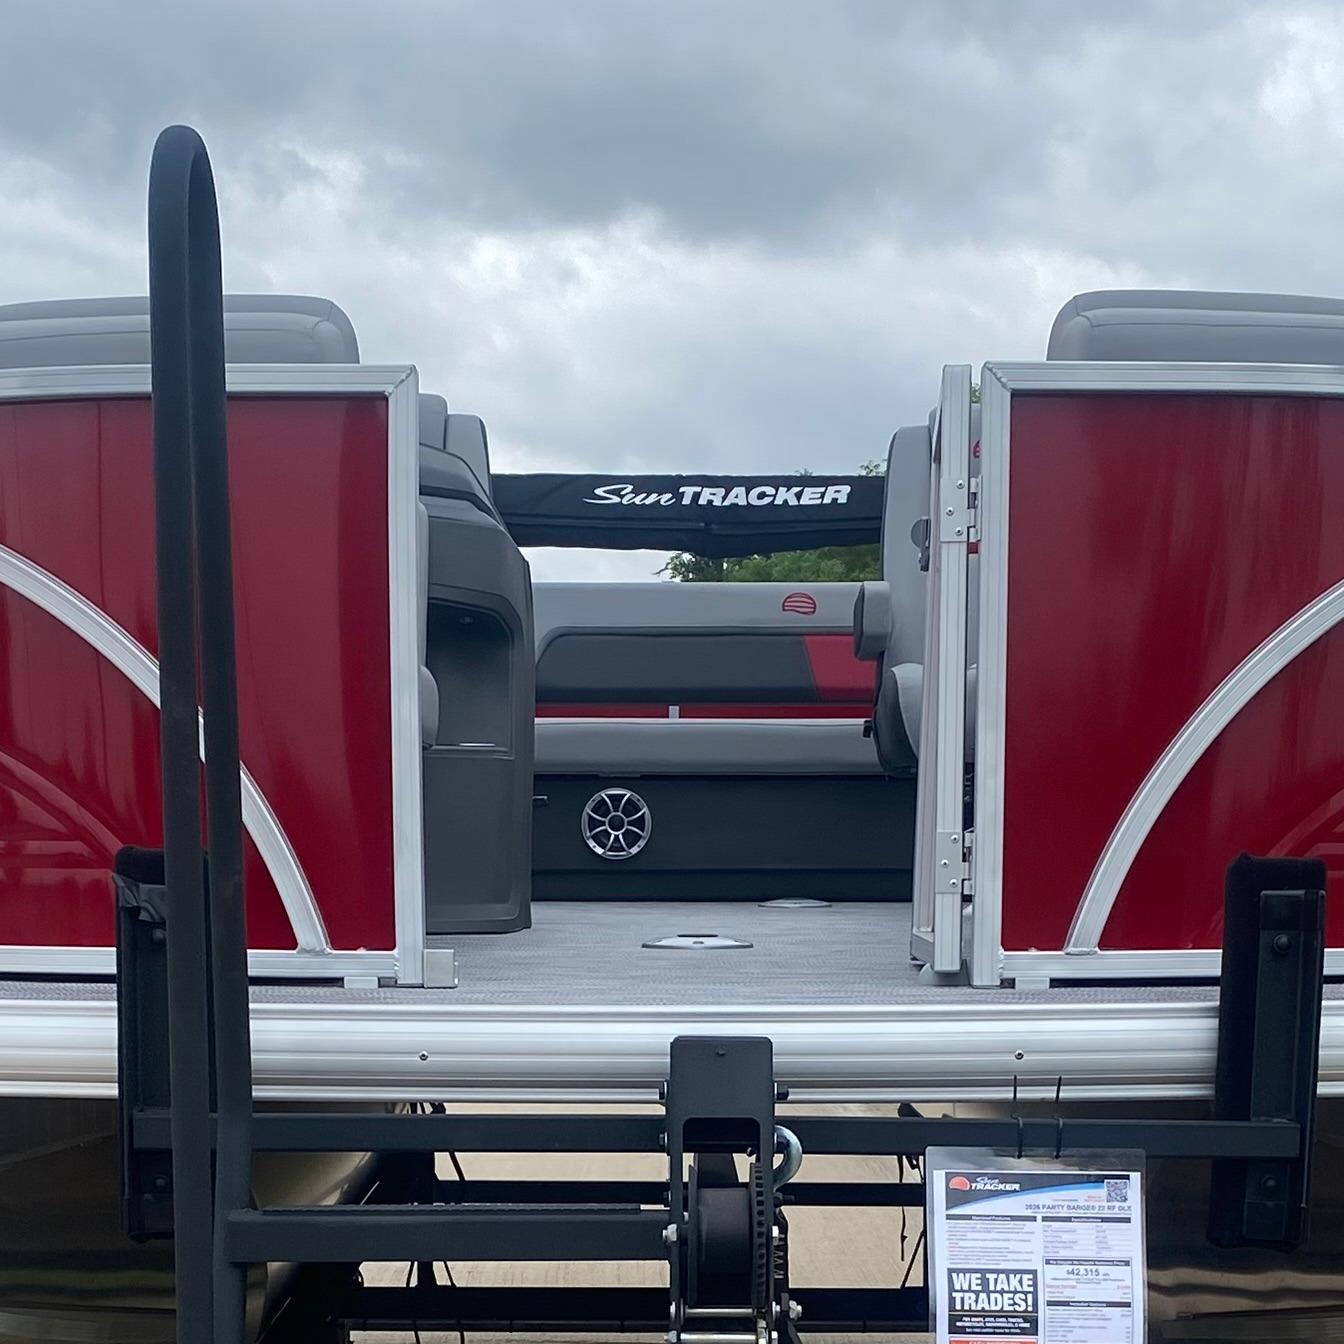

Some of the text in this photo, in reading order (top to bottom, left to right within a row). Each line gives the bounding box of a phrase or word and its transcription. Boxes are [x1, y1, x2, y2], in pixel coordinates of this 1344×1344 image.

[583, 484, 851, 507] Sun TRACKER
[970, 1183, 1021, 1191] TRACKER
[1041, 1203, 1065, 1211] PARTY
[952, 1272, 982, 1291] WE
[986, 1273, 1034, 1292] TAKE
[952, 1292, 1033, 1312] TRADES!
